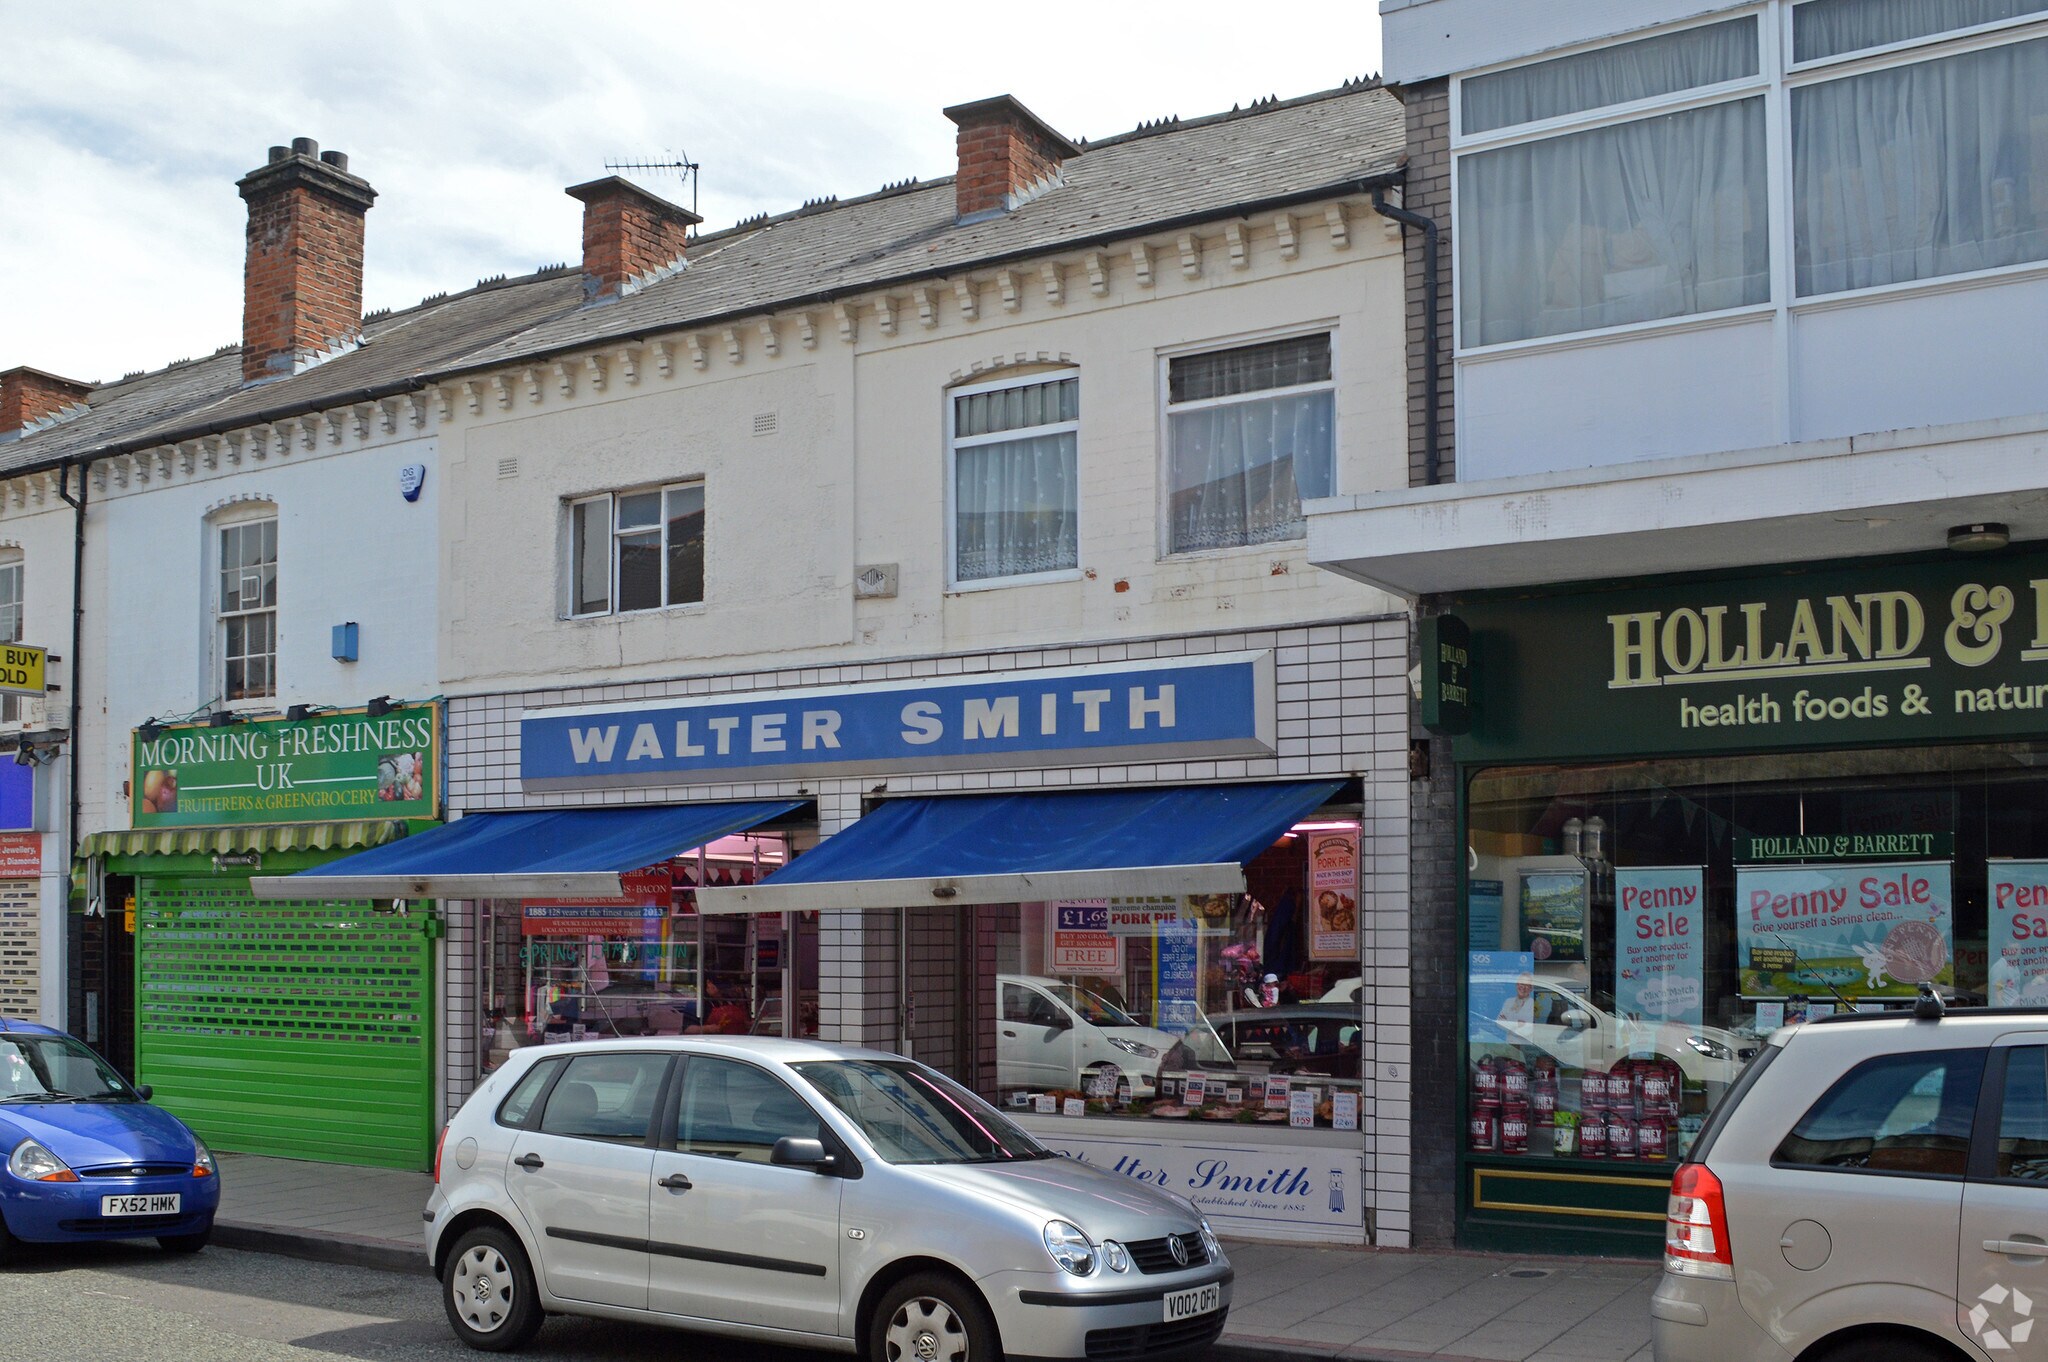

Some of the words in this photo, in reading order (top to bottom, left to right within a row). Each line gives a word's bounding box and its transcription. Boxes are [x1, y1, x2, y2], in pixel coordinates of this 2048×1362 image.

[1607, 590, 1925, 688] HOLLAND
[1944, 583, 2015, 667] &
[6, 650, 39, 667] BUY
[1441, 643, 1467, 668] HOLLAND
[1680, 693, 1781, 728] health
[1793, 686, 1888, 722] foods
[1900, 684, 1932, 715] &
[568, 709, 842, 764] WALTER
[900, 684, 1176, 745] SMITH
[140, 732, 268, 767] MORNING
[277, 718, 430, 757] FRESHNESS
[256, 763, 294, 790] UK
[178, 795, 253, 813] FRUITERERS
[255, 797, 263, 809] &
[265, 789, 376, 810] GREENGROCERY
[1751, 836, 1829, 858] HOLLAND
[1833, 835, 1849, 856] &
[1854, 833, 1934, 855] BARRETT
[1317, 858, 1337, 868] PORK
[1339, 856, 1351, 867] PIE
[636, 884, 668, 894] BACON
[1751, 887, 1847, 921] Penny
[1859, 873, 1931, 909] Sale
[1996, 882, 2048, 909] Pen
[1622, 885, 1697, 911] Penny
[529, 908, 546, 916] 1885
[562, 909, 580, 918] years
[580, 908, 589, 916] of
[589, 908, 601, 916] the
[603, 907, 622, 916] finest
[624, 909, 641, 917] meat
[643, 908, 663, 917] 2013
[1111, 904, 1141, 912] supreme
[1142, 902, 1177, 912] champion
[1062, 909, 1108, 925] £1.69
[1111, 911, 1150, 924] PORK
[1154, 911, 1177, 924] PIE
[1752, 922, 1774, 934] Give
[1777, 918, 1818, 934] yourself
[1820, 919, 1827, 927] a
[1830, 913, 1863, 928] Spring
[1636, 912, 1689, 939] Sale
[519, 942, 577, 967] SPRING
[1065, 950, 1107, 962] FREE
[1627, 946, 1641, 955] Buy
[1643, 945, 1658, 953] one
[2001, 947, 2017, 957] Buy
[2020, 946, 2036, 955] one
[1472, 954, 1491, 964] SOS
[1631, 955, 1643, 965] get
[1645, 953, 1675, 963] another
[1677, 952, 1689, 960] for
[1652, 964, 1676, 972] penny
[1582, 1079, 1606, 1087] WHEY
[1607, 1080, 1630, 1088] WHEY
[1644, 1081, 1670, 1090] WHEY
[1503, 1122, 1527, 1131] WHEY
[1581, 1127, 1606, 1135] WHEY
[1639, 1129, 1661, 1137] WHEY
[1189, 1160, 1313, 1197] Smith
[110, 1198, 147, 1213] FX52
[151, 1197, 175, 1211] HMK
[1190, 1195, 1247, 1208] Established
[1250, 1200, 1278, 1210] Since
[1283, 1203, 1306, 1212] 1885
